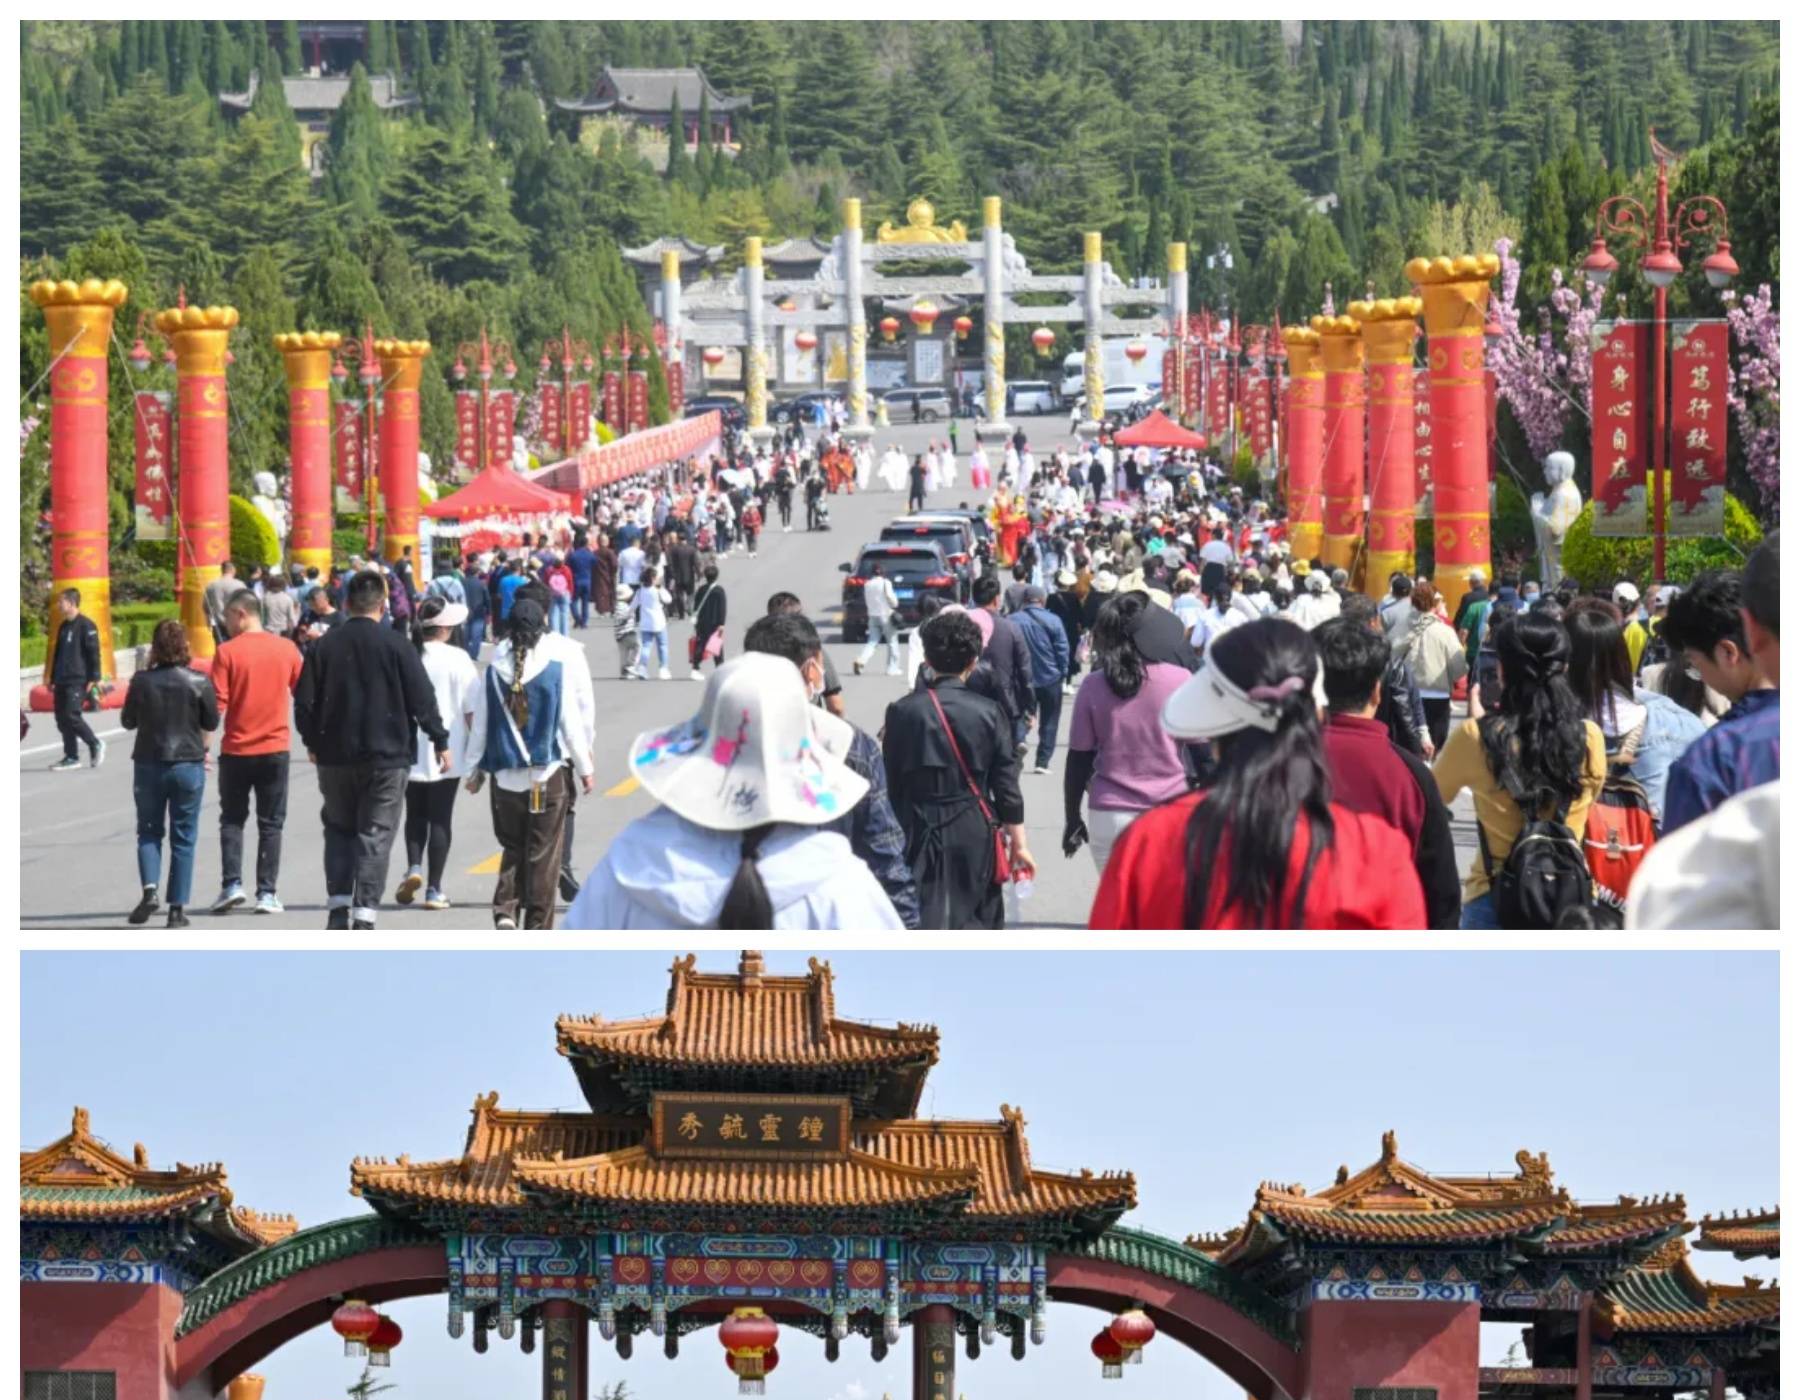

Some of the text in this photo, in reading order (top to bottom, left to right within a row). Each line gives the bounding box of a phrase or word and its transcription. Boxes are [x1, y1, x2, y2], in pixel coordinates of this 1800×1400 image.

[1415, 401, 1432, 480] 相由心生
[1608, 364, 1633, 479] 身心自在
